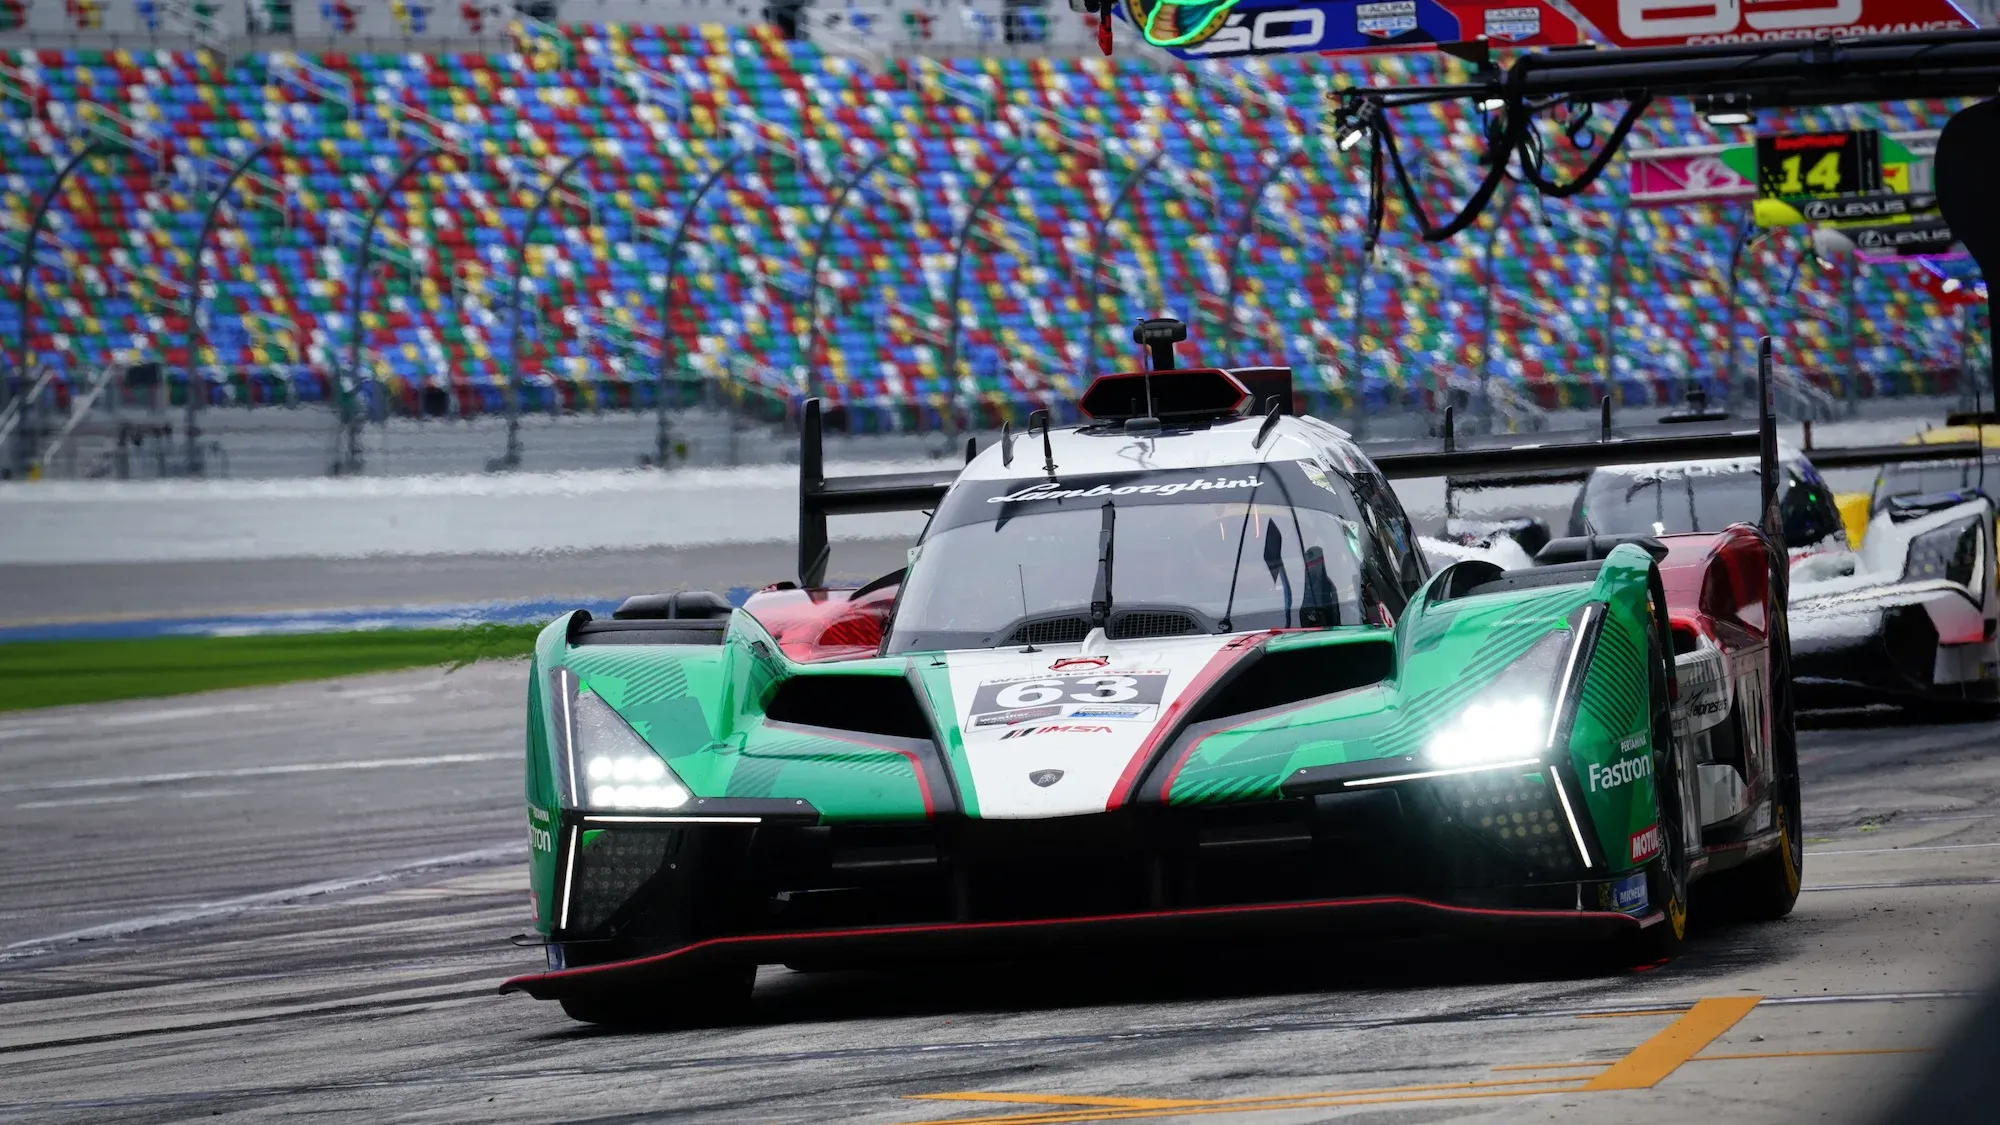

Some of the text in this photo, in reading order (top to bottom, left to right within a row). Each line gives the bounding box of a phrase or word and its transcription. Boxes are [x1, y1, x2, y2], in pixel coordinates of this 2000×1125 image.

[1779, 152, 1841, 193] 14
[1831, 200, 1906, 217] LEXUS
[1883, 229, 1951, 247] LEXUS
[987, 476, 1264, 503] Lamborghini
[996, 676, 1139, 708] 63
[1036, 725, 1113, 735] IMSA
[1620, 735, 1647, 753] PERTAMINA
[1589, 754, 1650, 793] Fastron
[1620, 885, 1645, 904] MICHELIN
